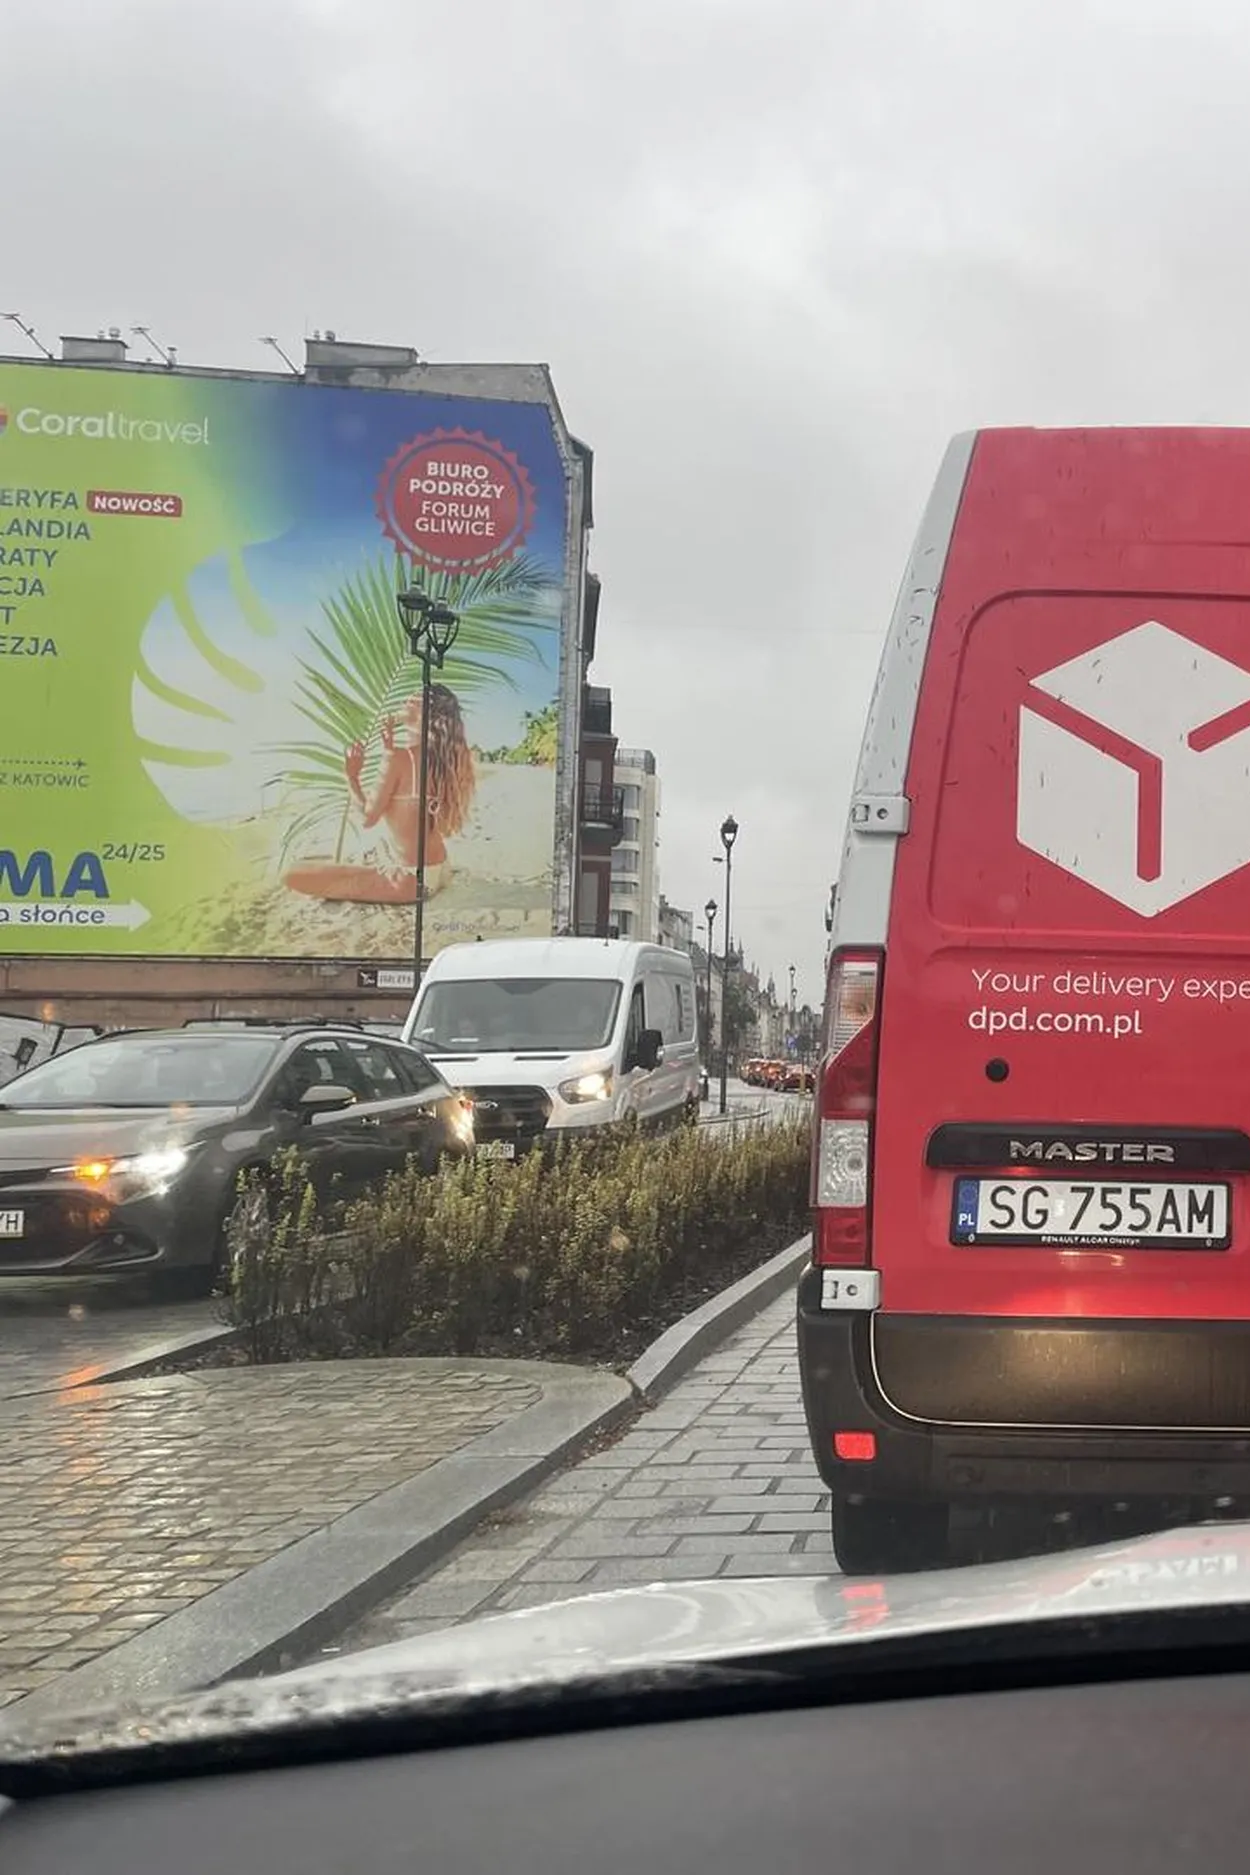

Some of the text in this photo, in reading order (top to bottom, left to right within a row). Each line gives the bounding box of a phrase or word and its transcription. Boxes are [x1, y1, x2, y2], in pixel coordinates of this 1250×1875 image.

[427, 461, 489, 480] BIURO
[409, 478, 504, 499] PODRÓŻY
[94, 496, 175, 514] NOWOŚĆ
[421, 500, 490, 519] FORUM
[0, 518, 91, 541] ANDIA
[414, 517, 496, 537] GLIWICE
[13, 773, 90, 787] KATOWIC
[102, 843, 165, 863] 24/25
[20, 903, 106, 924] słońce
[972, 969, 1045, 993] Your
[1053, 970, 1176, 1002] delivery
[968, 1006, 1143, 1038] dpd.com.pl
[1010, 1140, 1175, 1163] MASTER
[958, 1185, 1214, 1234] PL SG 755AM
